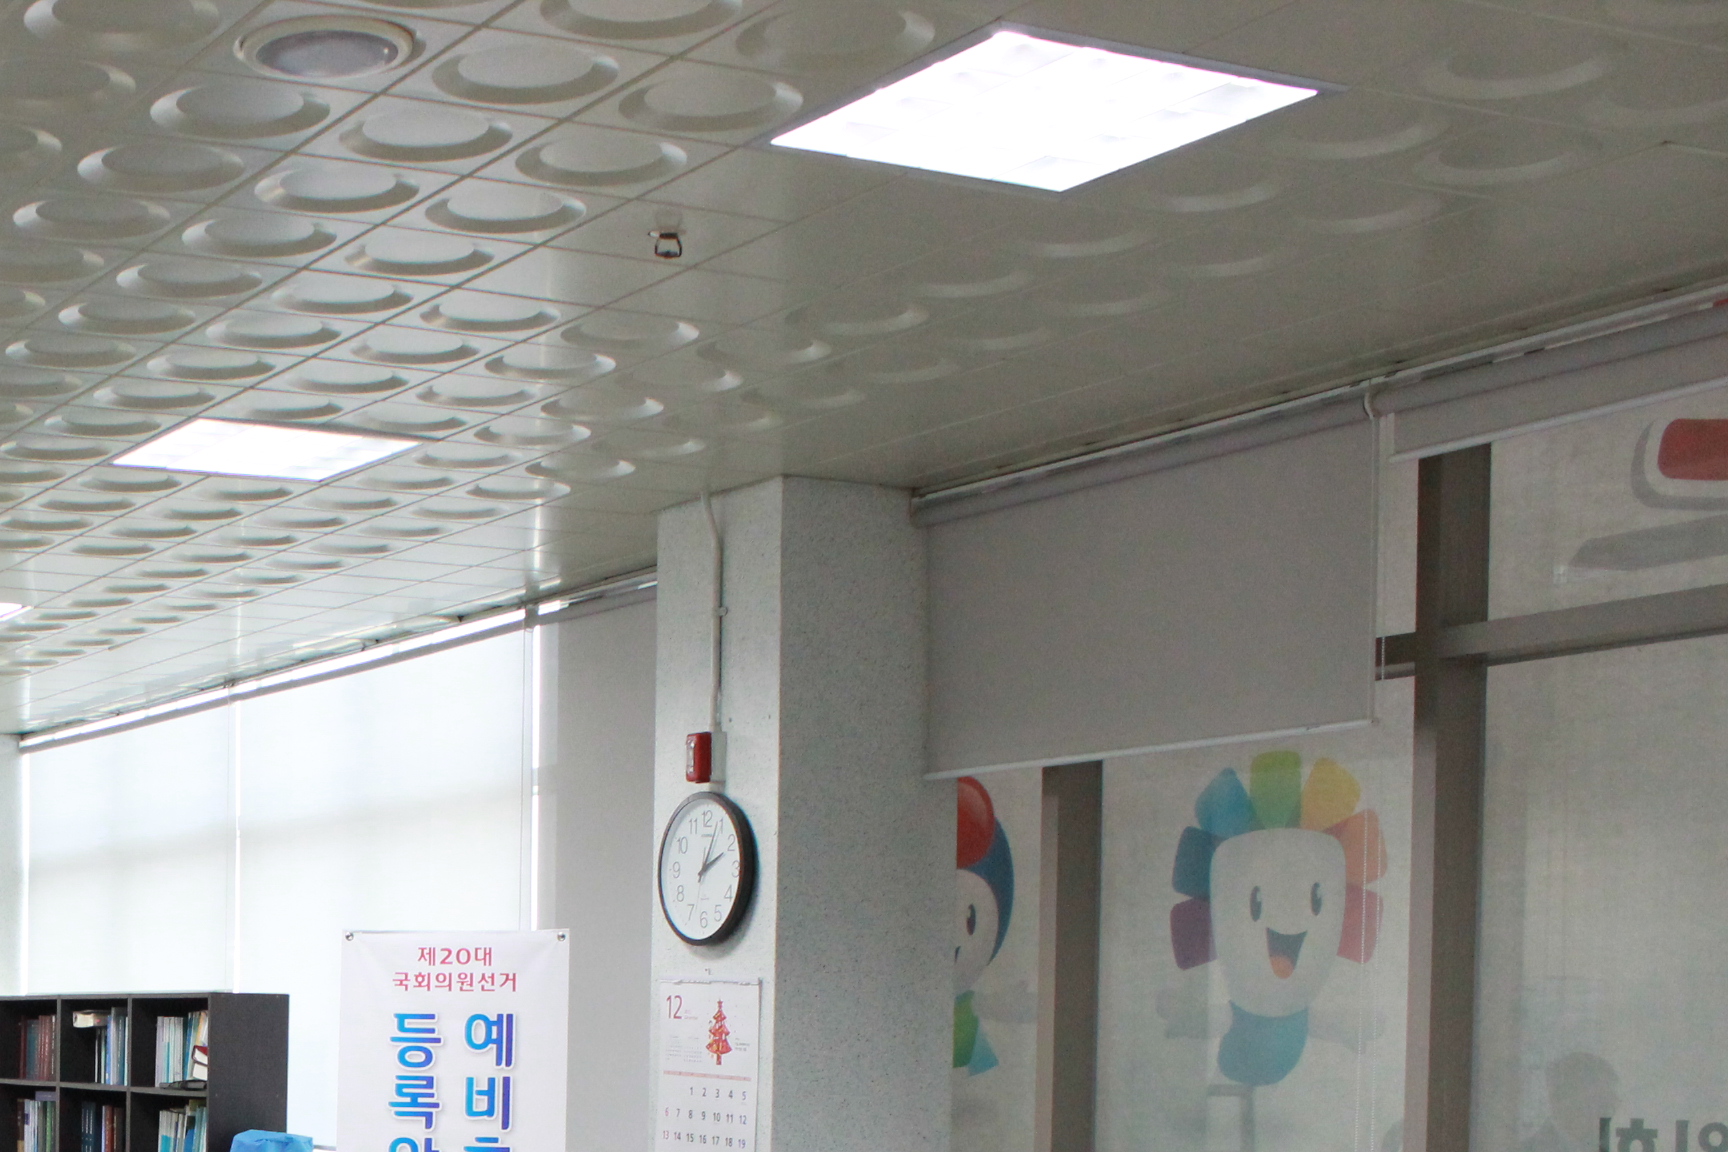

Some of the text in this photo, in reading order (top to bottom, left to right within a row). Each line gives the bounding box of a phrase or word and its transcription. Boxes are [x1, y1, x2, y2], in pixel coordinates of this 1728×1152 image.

[689, 818, 697, 834] 11
[702, 810, 712, 827] 12
[720, 817, 723, 834] 1
[677, 836, 688, 854] 10
[727, 834, 735, 851] 2
[673, 862, 680, 878] 9
[732, 860, 739, 878] 3
[677, 885, 684, 902] 8
[724, 885, 733, 902] 4
[687, 904, 694, 920] 7
[700, 911, 708, 928] 6
[714, 905, 722, 922] 5
[417, 946, 493, 967] 제20대
[392, 971, 518, 993] 국회의원선거
[666, 995, 683, 1020] 12
[690, 1087, 747, 1100] 1 2 3 4 5
[665, 1107, 747, 1125] 6 7 8 9 10 11 12
[663, 1130, 746, 1149] 13 14 15 16 17 18 19
